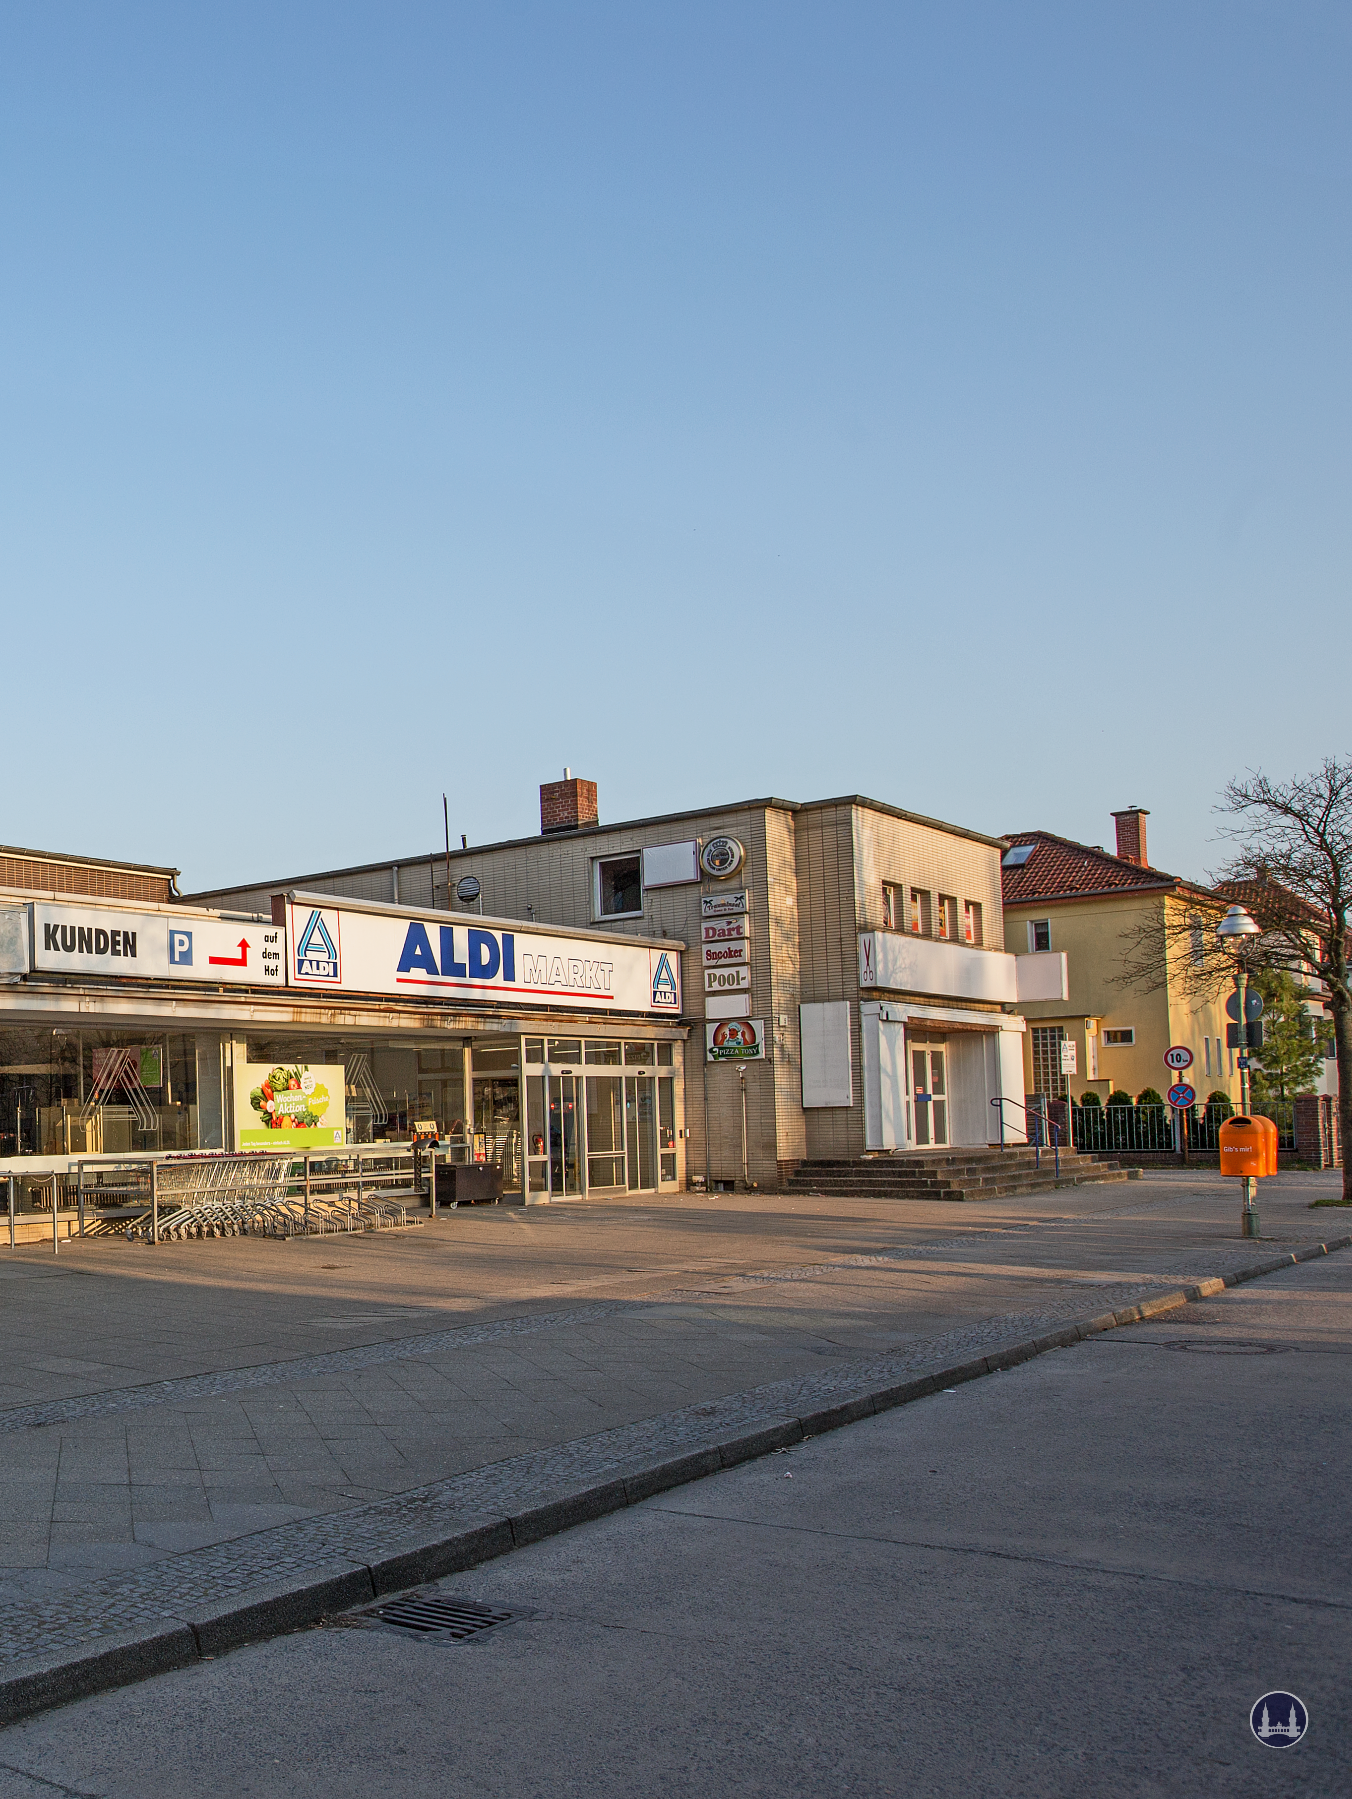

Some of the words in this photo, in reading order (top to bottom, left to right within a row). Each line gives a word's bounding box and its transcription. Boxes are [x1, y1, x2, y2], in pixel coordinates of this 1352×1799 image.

[264, 931, 278, 943] auf
[704, 924, 743, 939] Dart
[44, 923, 137, 958] KUNDEN
[174, 933, 190, 962] P
[705, 946, 743, 961] Snooker
[262, 949, 280, 961] dem
[397, 922, 515, 982] ALDI
[523, 953, 613, 990] MARKT
[264, 964, 279, 977] Hof
[301, 960, 334, 976] ALDI
[707, 970, 746, 988] Pool-
[655, 991, 675, 1004] ALDI
[719, 1048, 740, 1056] PIZZA
[741, 1046, 758, 1055] TONY
[1170, 1053, 1182, 1063] 10
[276, 1093, 307, 1103] Wochen-
[278, 1103, 307, 1114] Aktion
[1239, 1145, 1253, 1153] mir!
